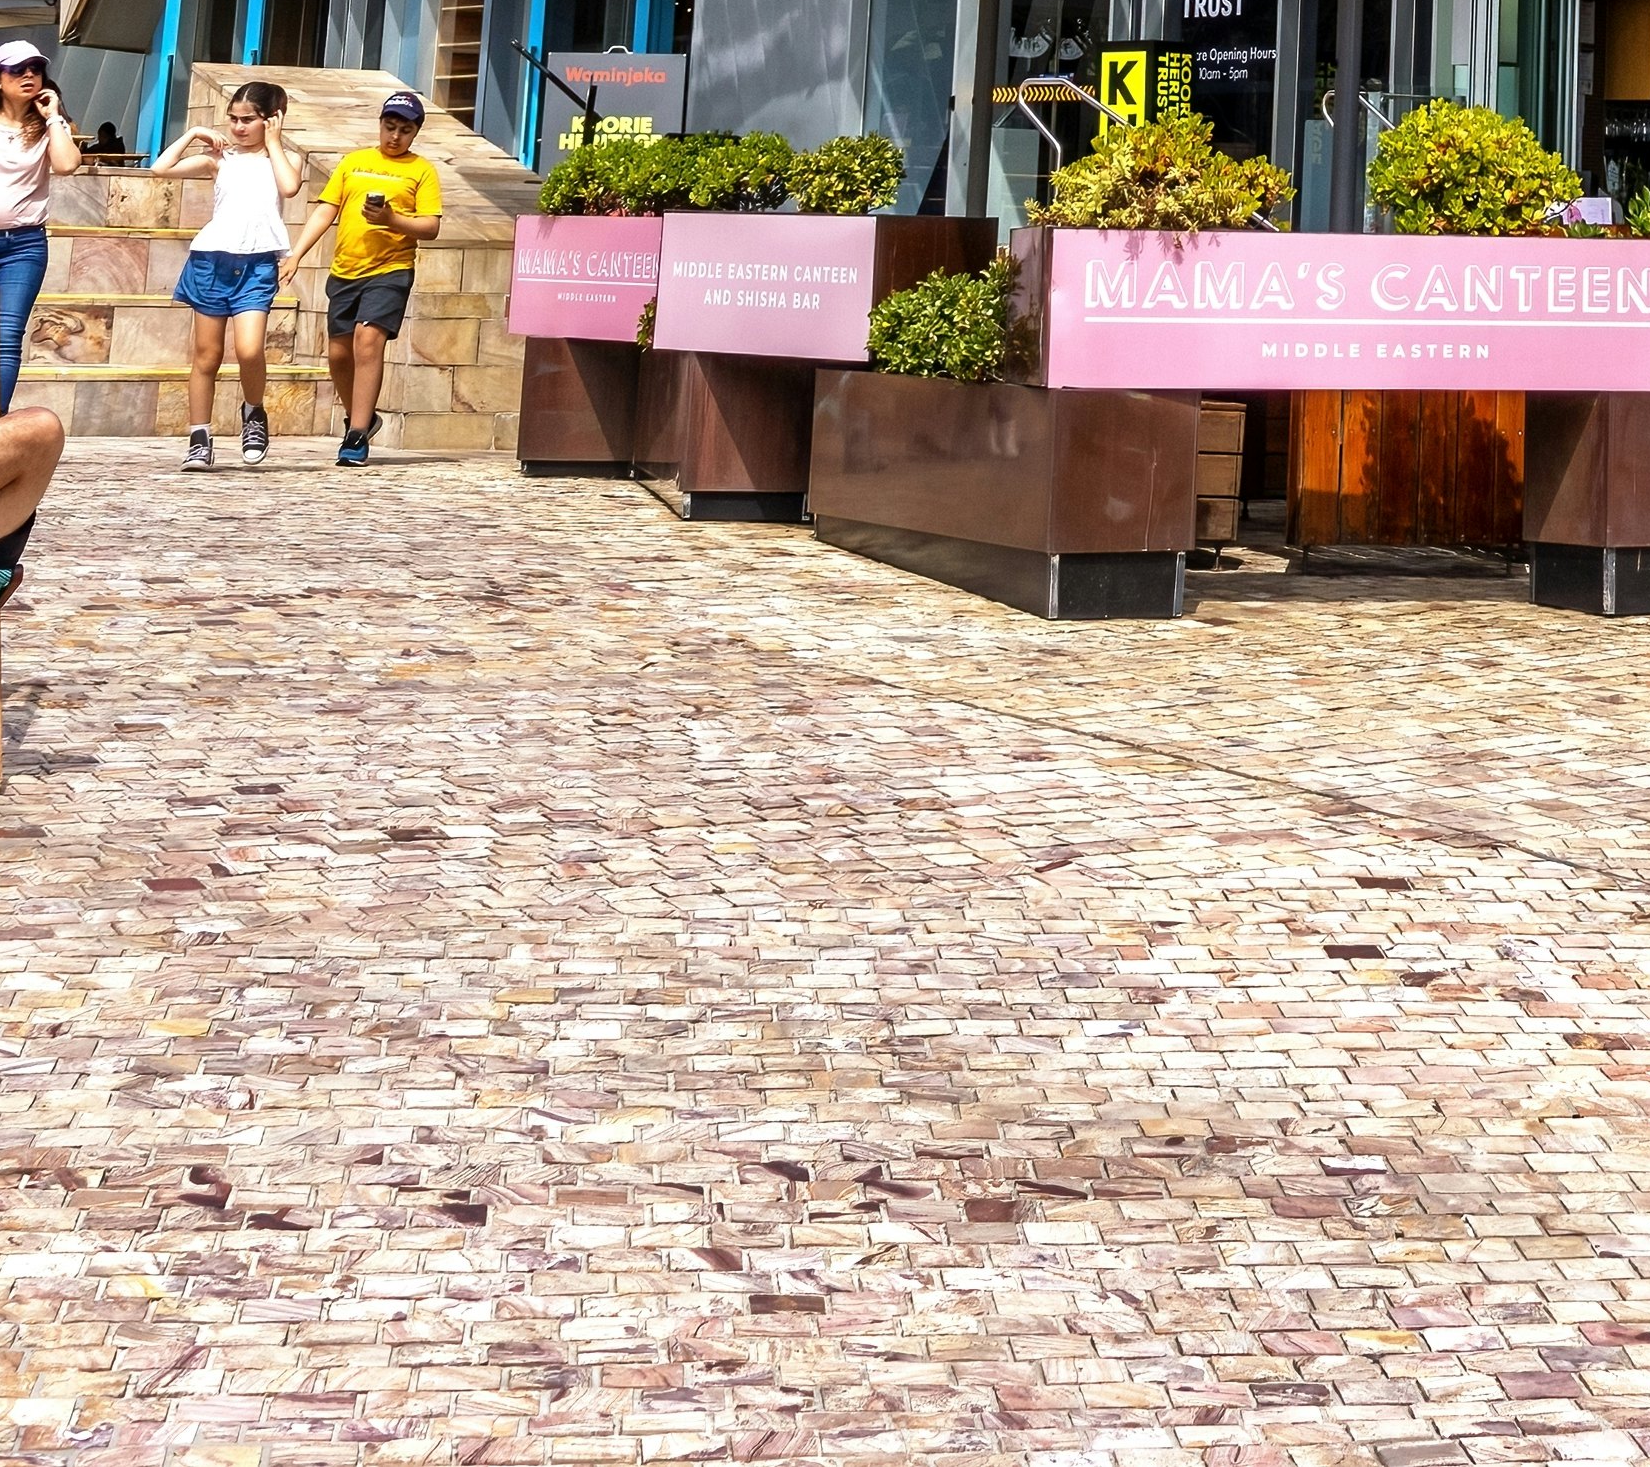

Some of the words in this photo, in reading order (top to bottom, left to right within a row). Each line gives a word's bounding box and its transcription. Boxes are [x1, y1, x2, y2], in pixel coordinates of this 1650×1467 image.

[1210, 47, 1248, 64] Opening
[1250, 46, 1277, 60] Hours
[1169, 52, 1181, 117] HERIT
[1229, 66, 1249, 81] 5pm
[1181, 53, 1192, 117] KOOR
[517, 249, 581, 276] MAMA'S
[672, 261, 723, 279] MIDDLE
[727, 263, 788, 282] EASTERN
[794, 266, 858, 284] CANTEEN
[1084, 259, 1347, 311] MAMA'S
[557, 292, 583, 302] MIDDLE
[585, 293, 617, 303] EASTERN
[703, 289, 732, 305] AND
[736, 290, 787, 309] SHISHA
[792, 293, 821, 310] BAR
[1261, 342, 1361, 358] MIDDLE
[1376, 343, 1490, 360] EASTERN
